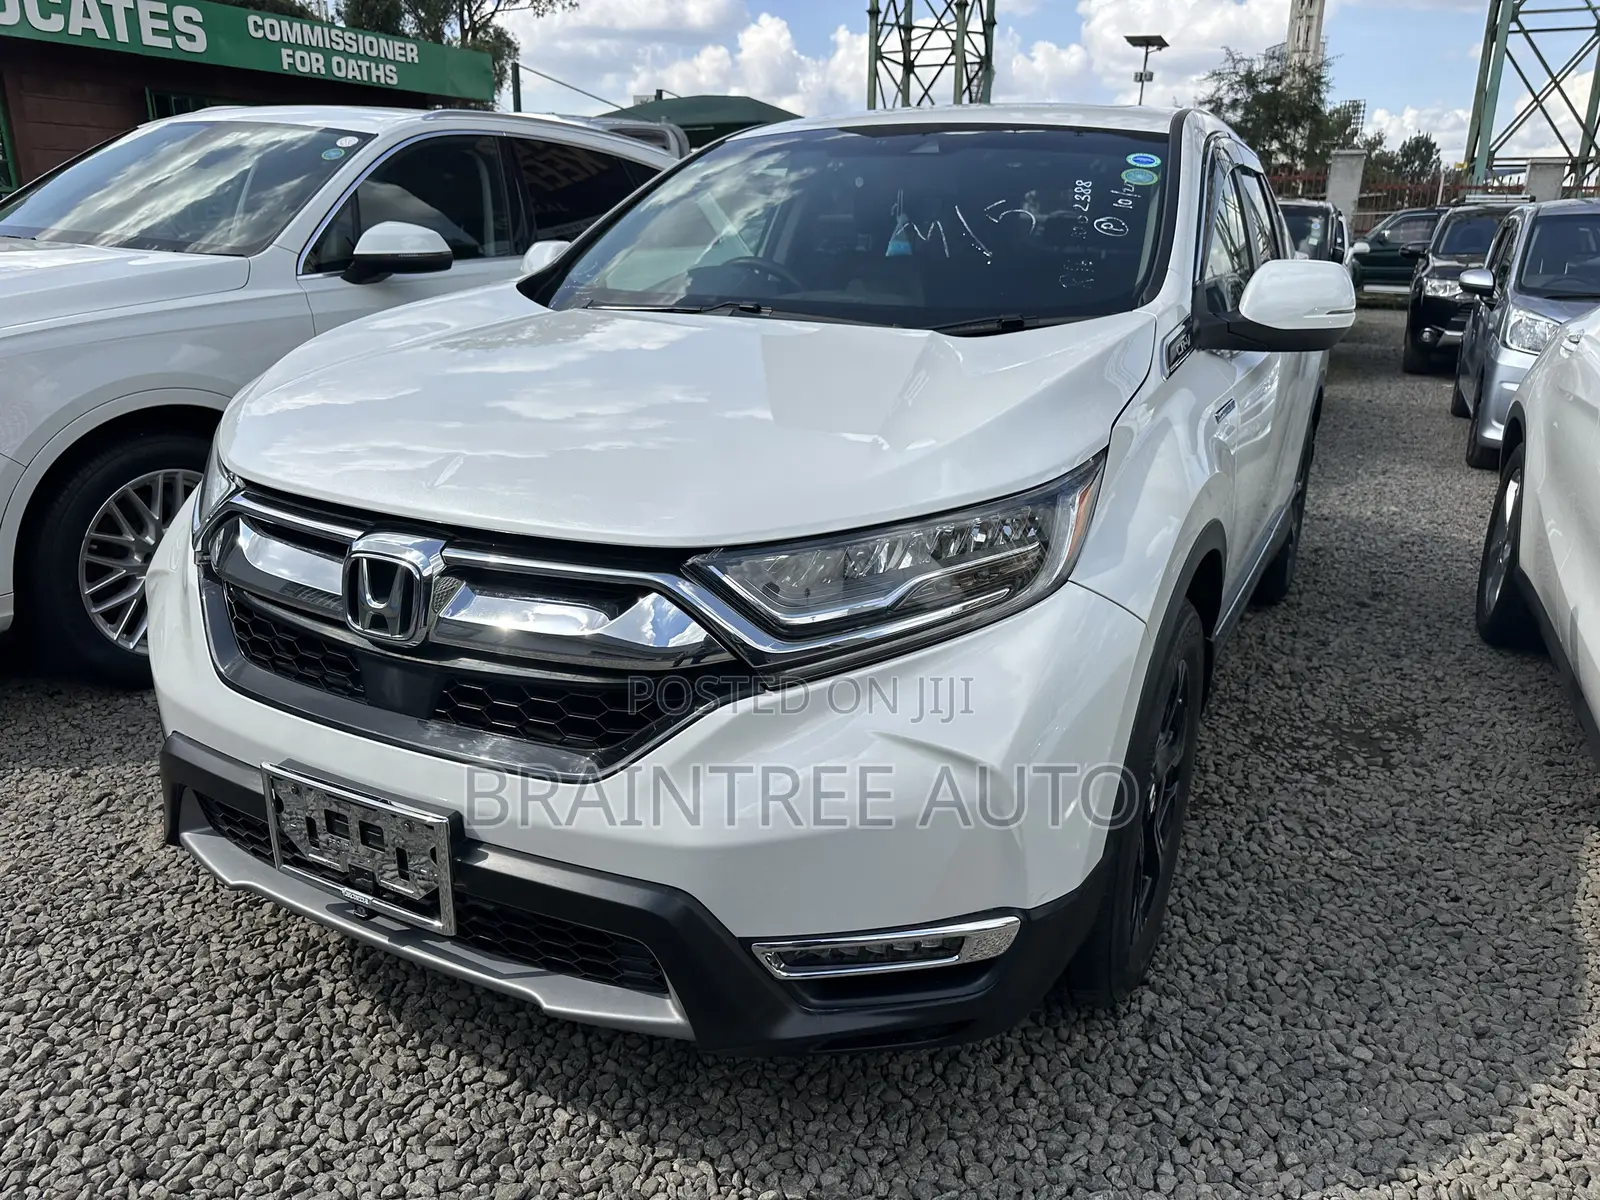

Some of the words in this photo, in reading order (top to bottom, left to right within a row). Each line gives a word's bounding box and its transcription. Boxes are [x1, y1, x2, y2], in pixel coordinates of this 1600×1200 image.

[247, 14, 419, 64] COMMISSIONER
[280, 48, 326, 76] FOR
[331, 56, 399, 86] OATHS
